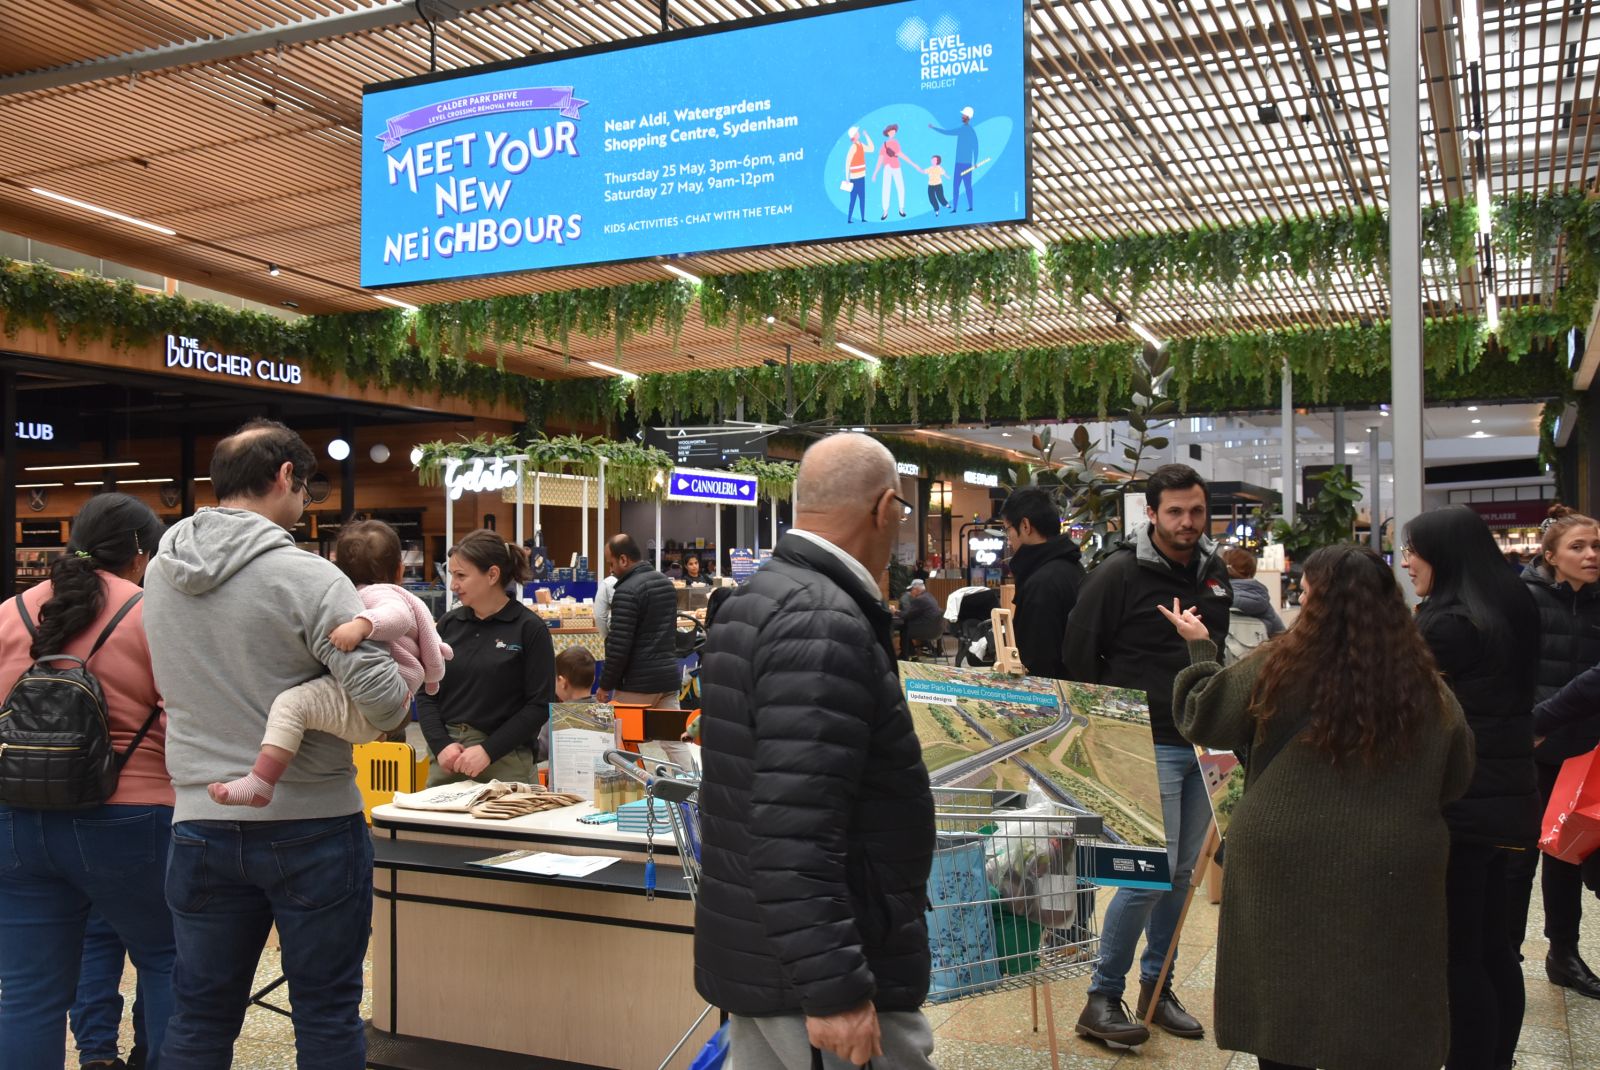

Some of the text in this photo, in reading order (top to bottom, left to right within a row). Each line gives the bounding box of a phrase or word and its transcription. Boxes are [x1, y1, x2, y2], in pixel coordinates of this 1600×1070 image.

[920, 34, 965, 52] LEVEL
[920, 43, 993, 66] CROSSING
[920, 59, 989, 80] REMOVAL
[920, 78, 957, 90] PROJECT
[428, 99, 533, 124] LEVEL CROSSING REMOVAL PROJECT
[436, 91, 518, 113] CALDER PARK DRIVE
[604, 99, 771, 133] Near Aldi, Watergardens
[604, 115, 798, 152] Shopping Centre, Sydenham
[386, 121, 578, 193] MEET YOUR
[604, 148, 804, 185] Thursday 25 May, 3pm-6pm, and
[435, 176, 512, 217] NEW
[604, 171, 775, 202] Saturday 27 May, 9am-12pm
[604, 204, 793, 233] KIDS ACTIVITIES CHAT WITH THE TEAM
[180, 336, 199, 349] THE
[256, 360, 302, 385] CLUB
[691, 479, 738, 496] CANNOLERIA
[909, 681, 1053, 706] Calder Park Drive Level Crossing Removal Project
[910, 693, 952, 704] Updated designs
